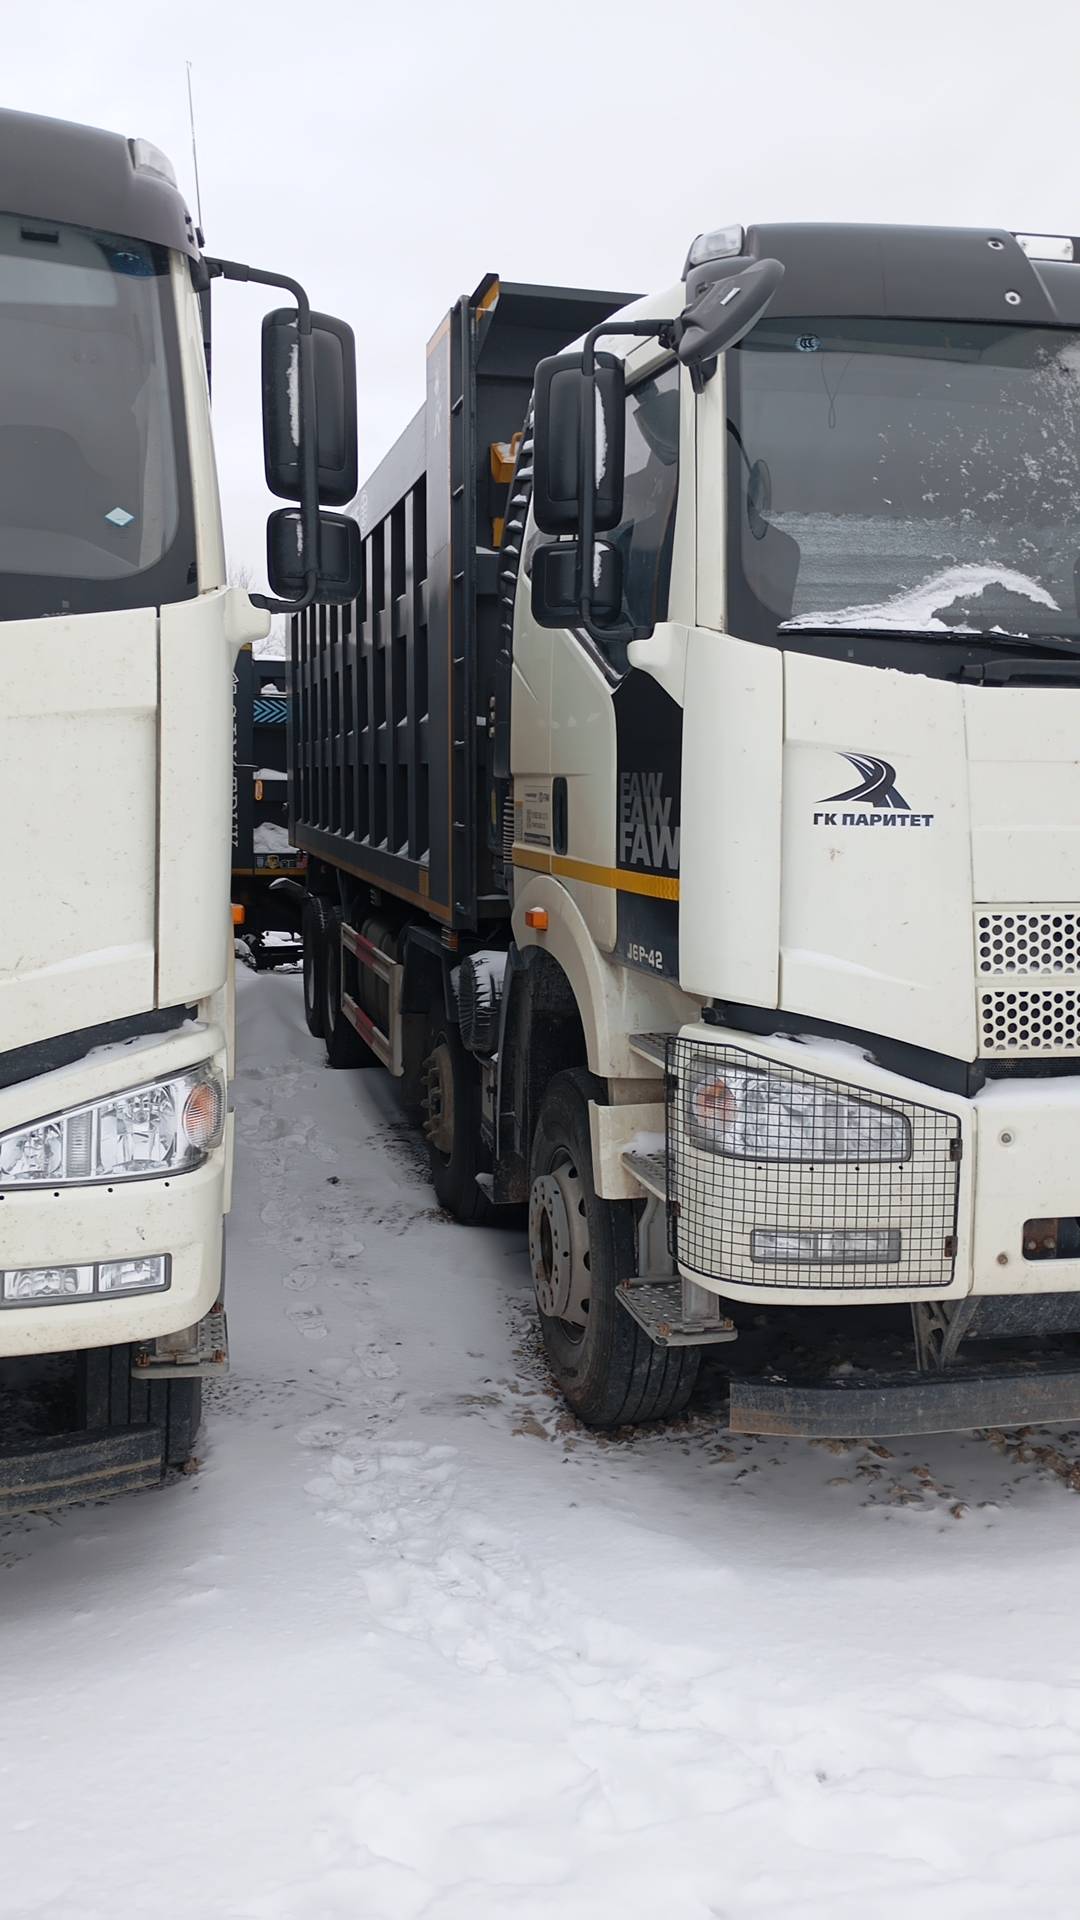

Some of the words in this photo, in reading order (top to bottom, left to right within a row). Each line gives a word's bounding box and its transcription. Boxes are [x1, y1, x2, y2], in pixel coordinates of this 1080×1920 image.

[813, 812, 838, 826] ГК
[841, 813, 934, 827] ПАРИТЕТ
[619, 822, 681, 870] FAW
[627, 943, 663, 970] J6P-42
